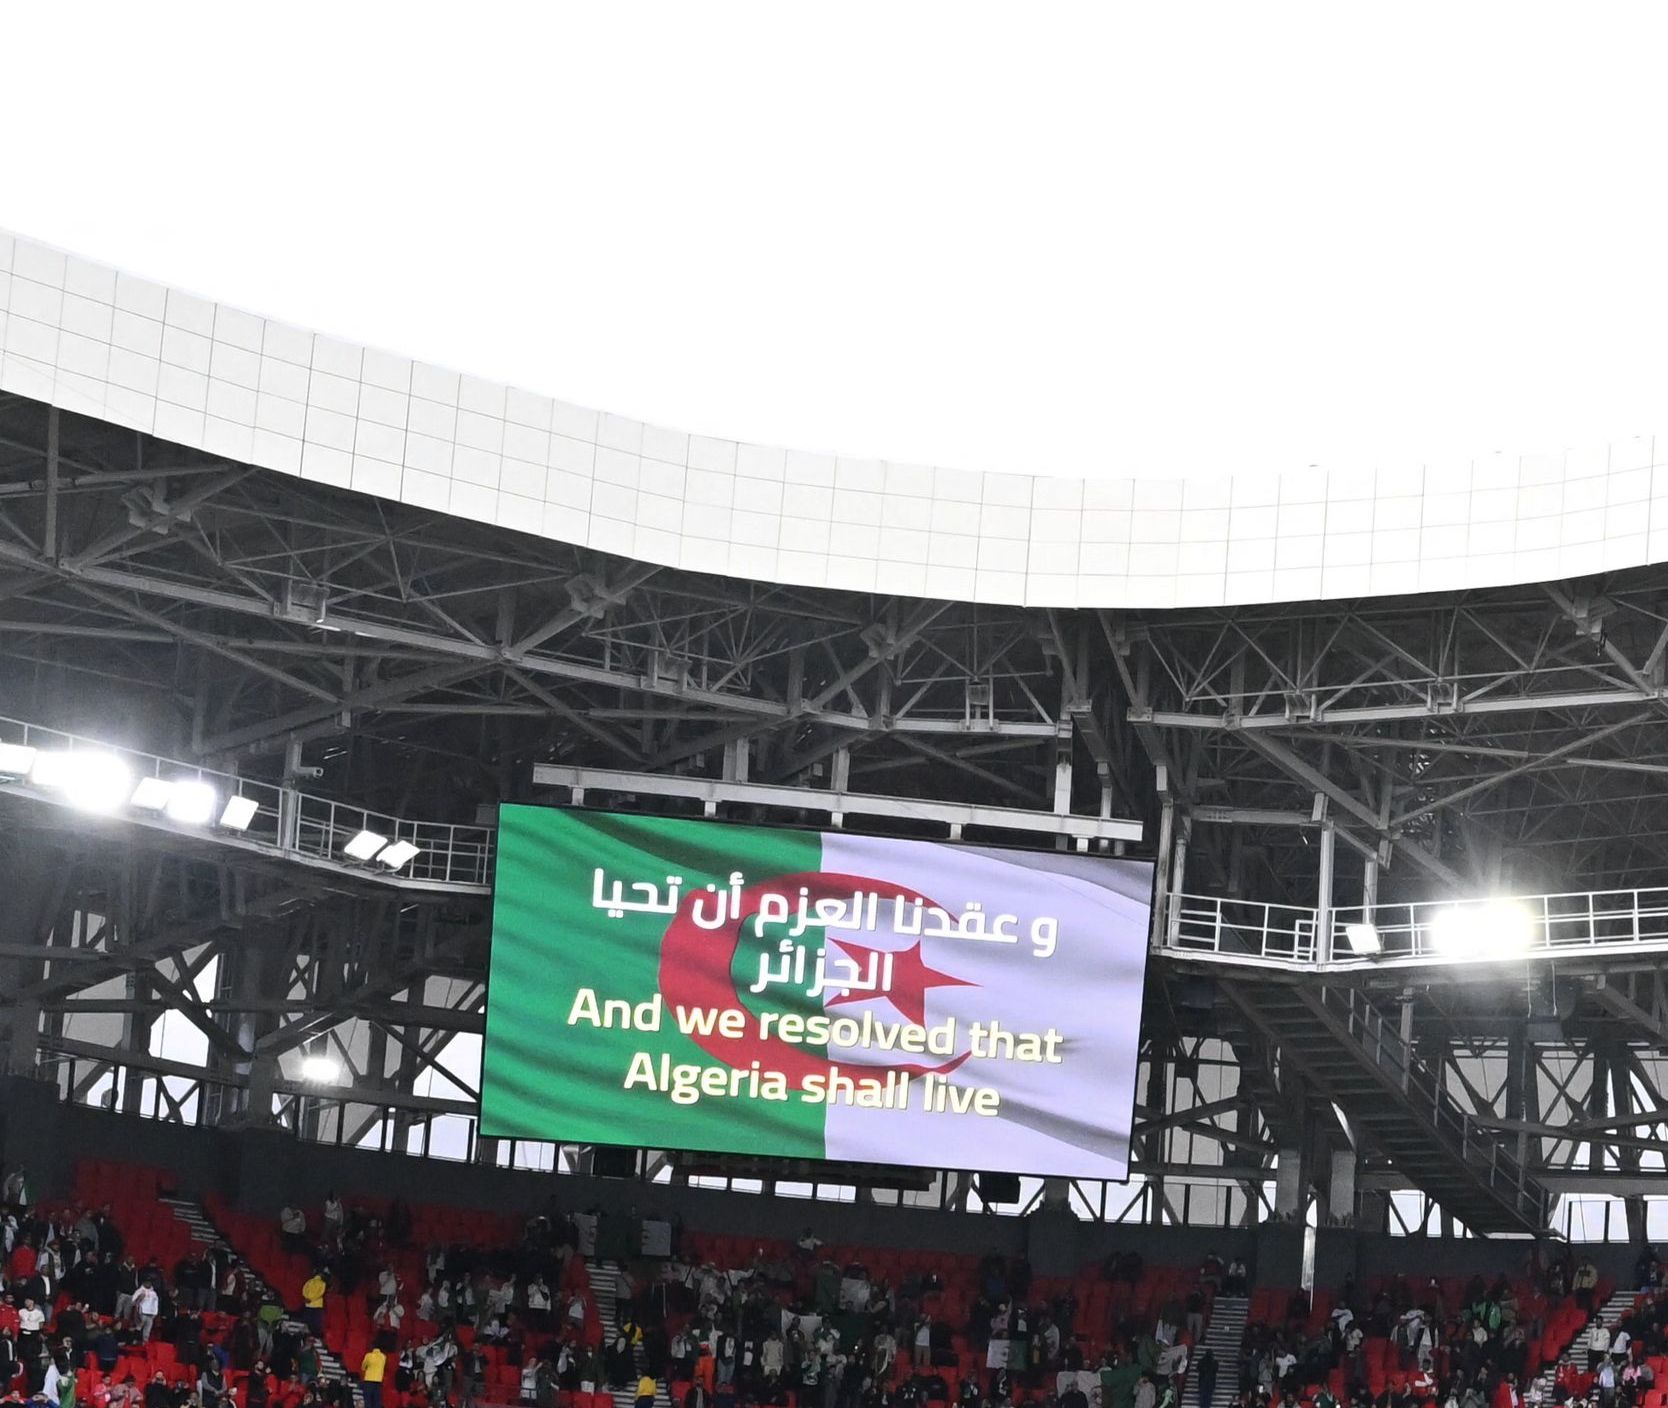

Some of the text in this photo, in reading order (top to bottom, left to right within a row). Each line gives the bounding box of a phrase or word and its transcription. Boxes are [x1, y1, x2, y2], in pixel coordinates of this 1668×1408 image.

[593, 868, 683, 918] تحيا
[692, 872, 744, 930] أن
[755, 887, 878, 937] العزم
[750, 939, 893, 998] الجزائر
[568, 988, 1063, 1063] And we resolved that
[624, 1052, 1000, 1116] Algeria shall live
